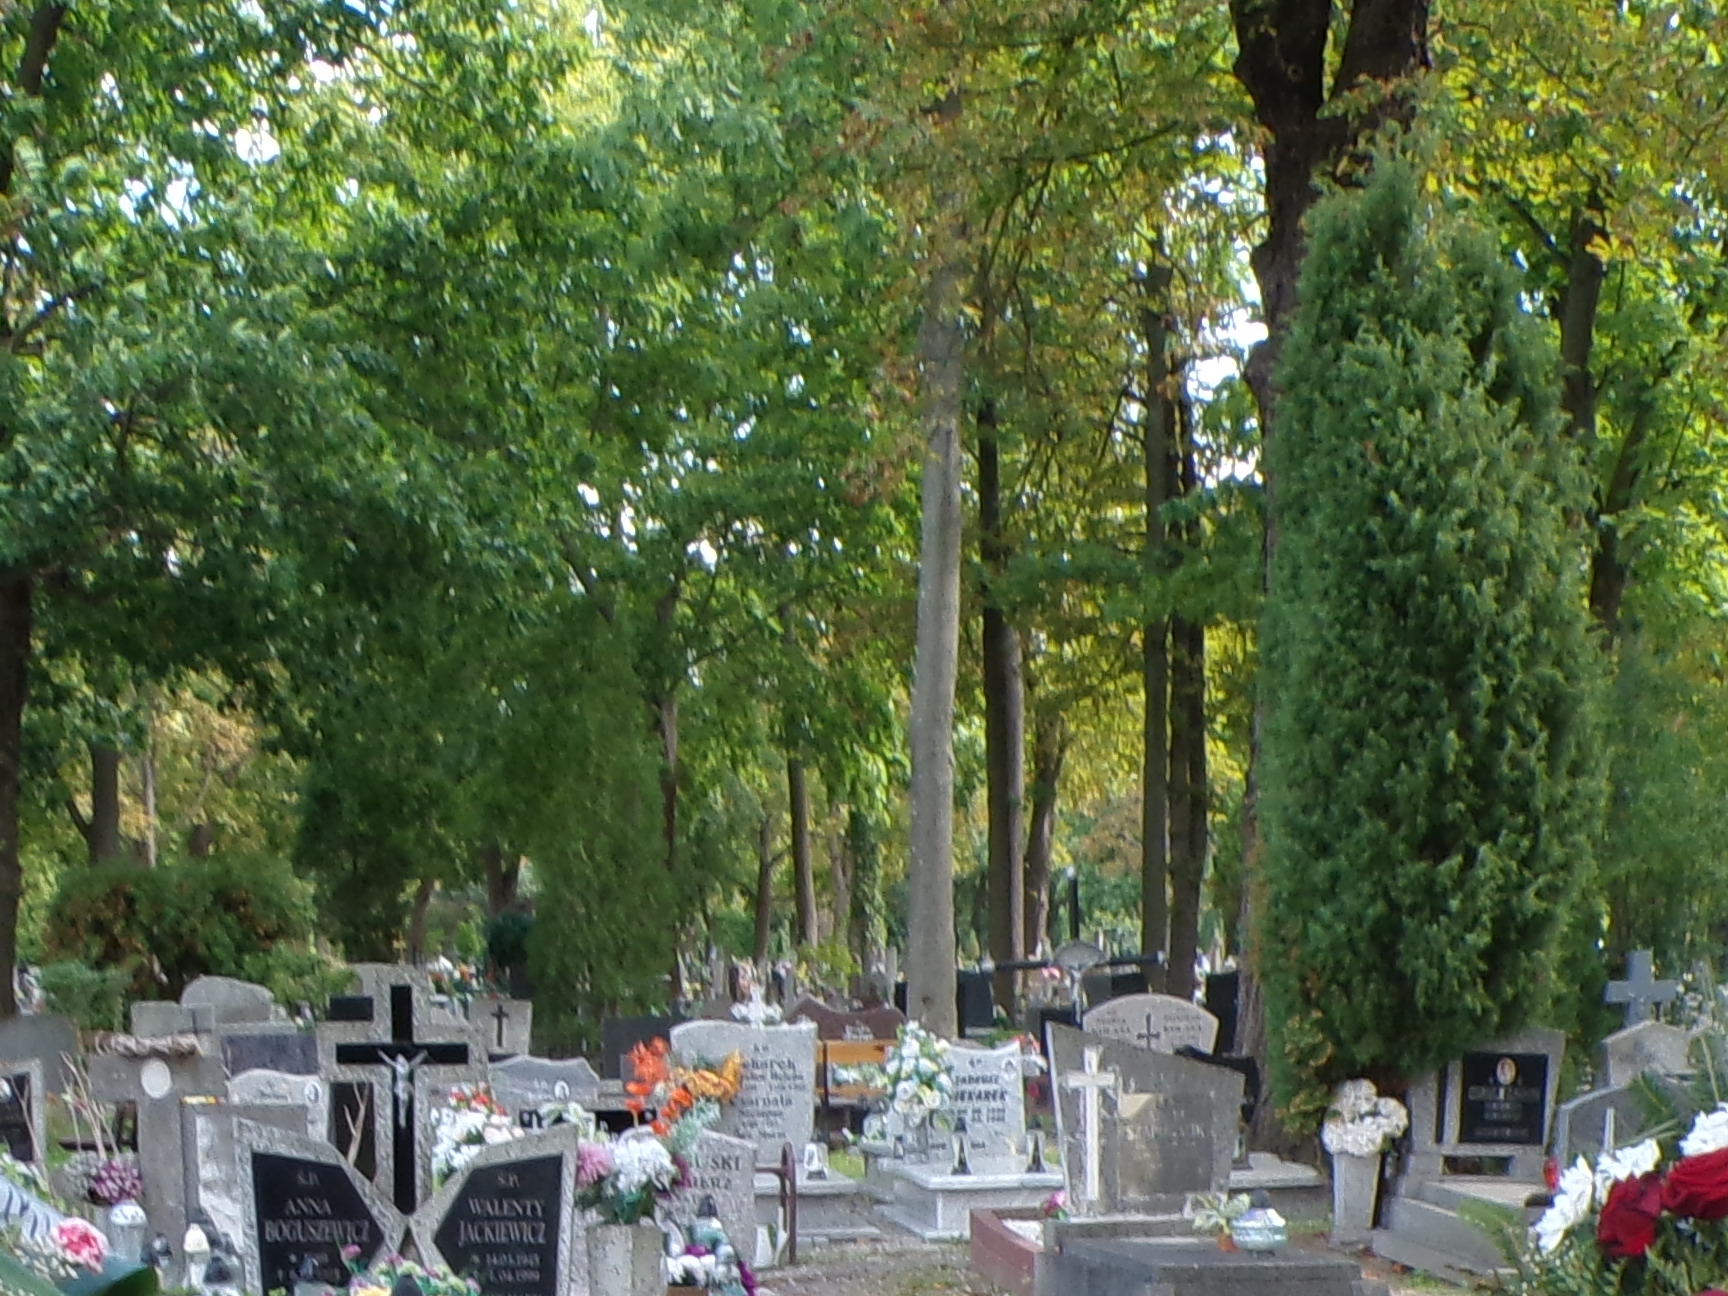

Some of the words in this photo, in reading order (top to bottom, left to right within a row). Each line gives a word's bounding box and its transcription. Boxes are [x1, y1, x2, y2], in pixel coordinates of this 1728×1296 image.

[286, 1198, 332, 1216] ANNA
[467, 1197, 545, 1218] WALENTY
[457, 1220, 547, 1248] JACKIEWICZ
